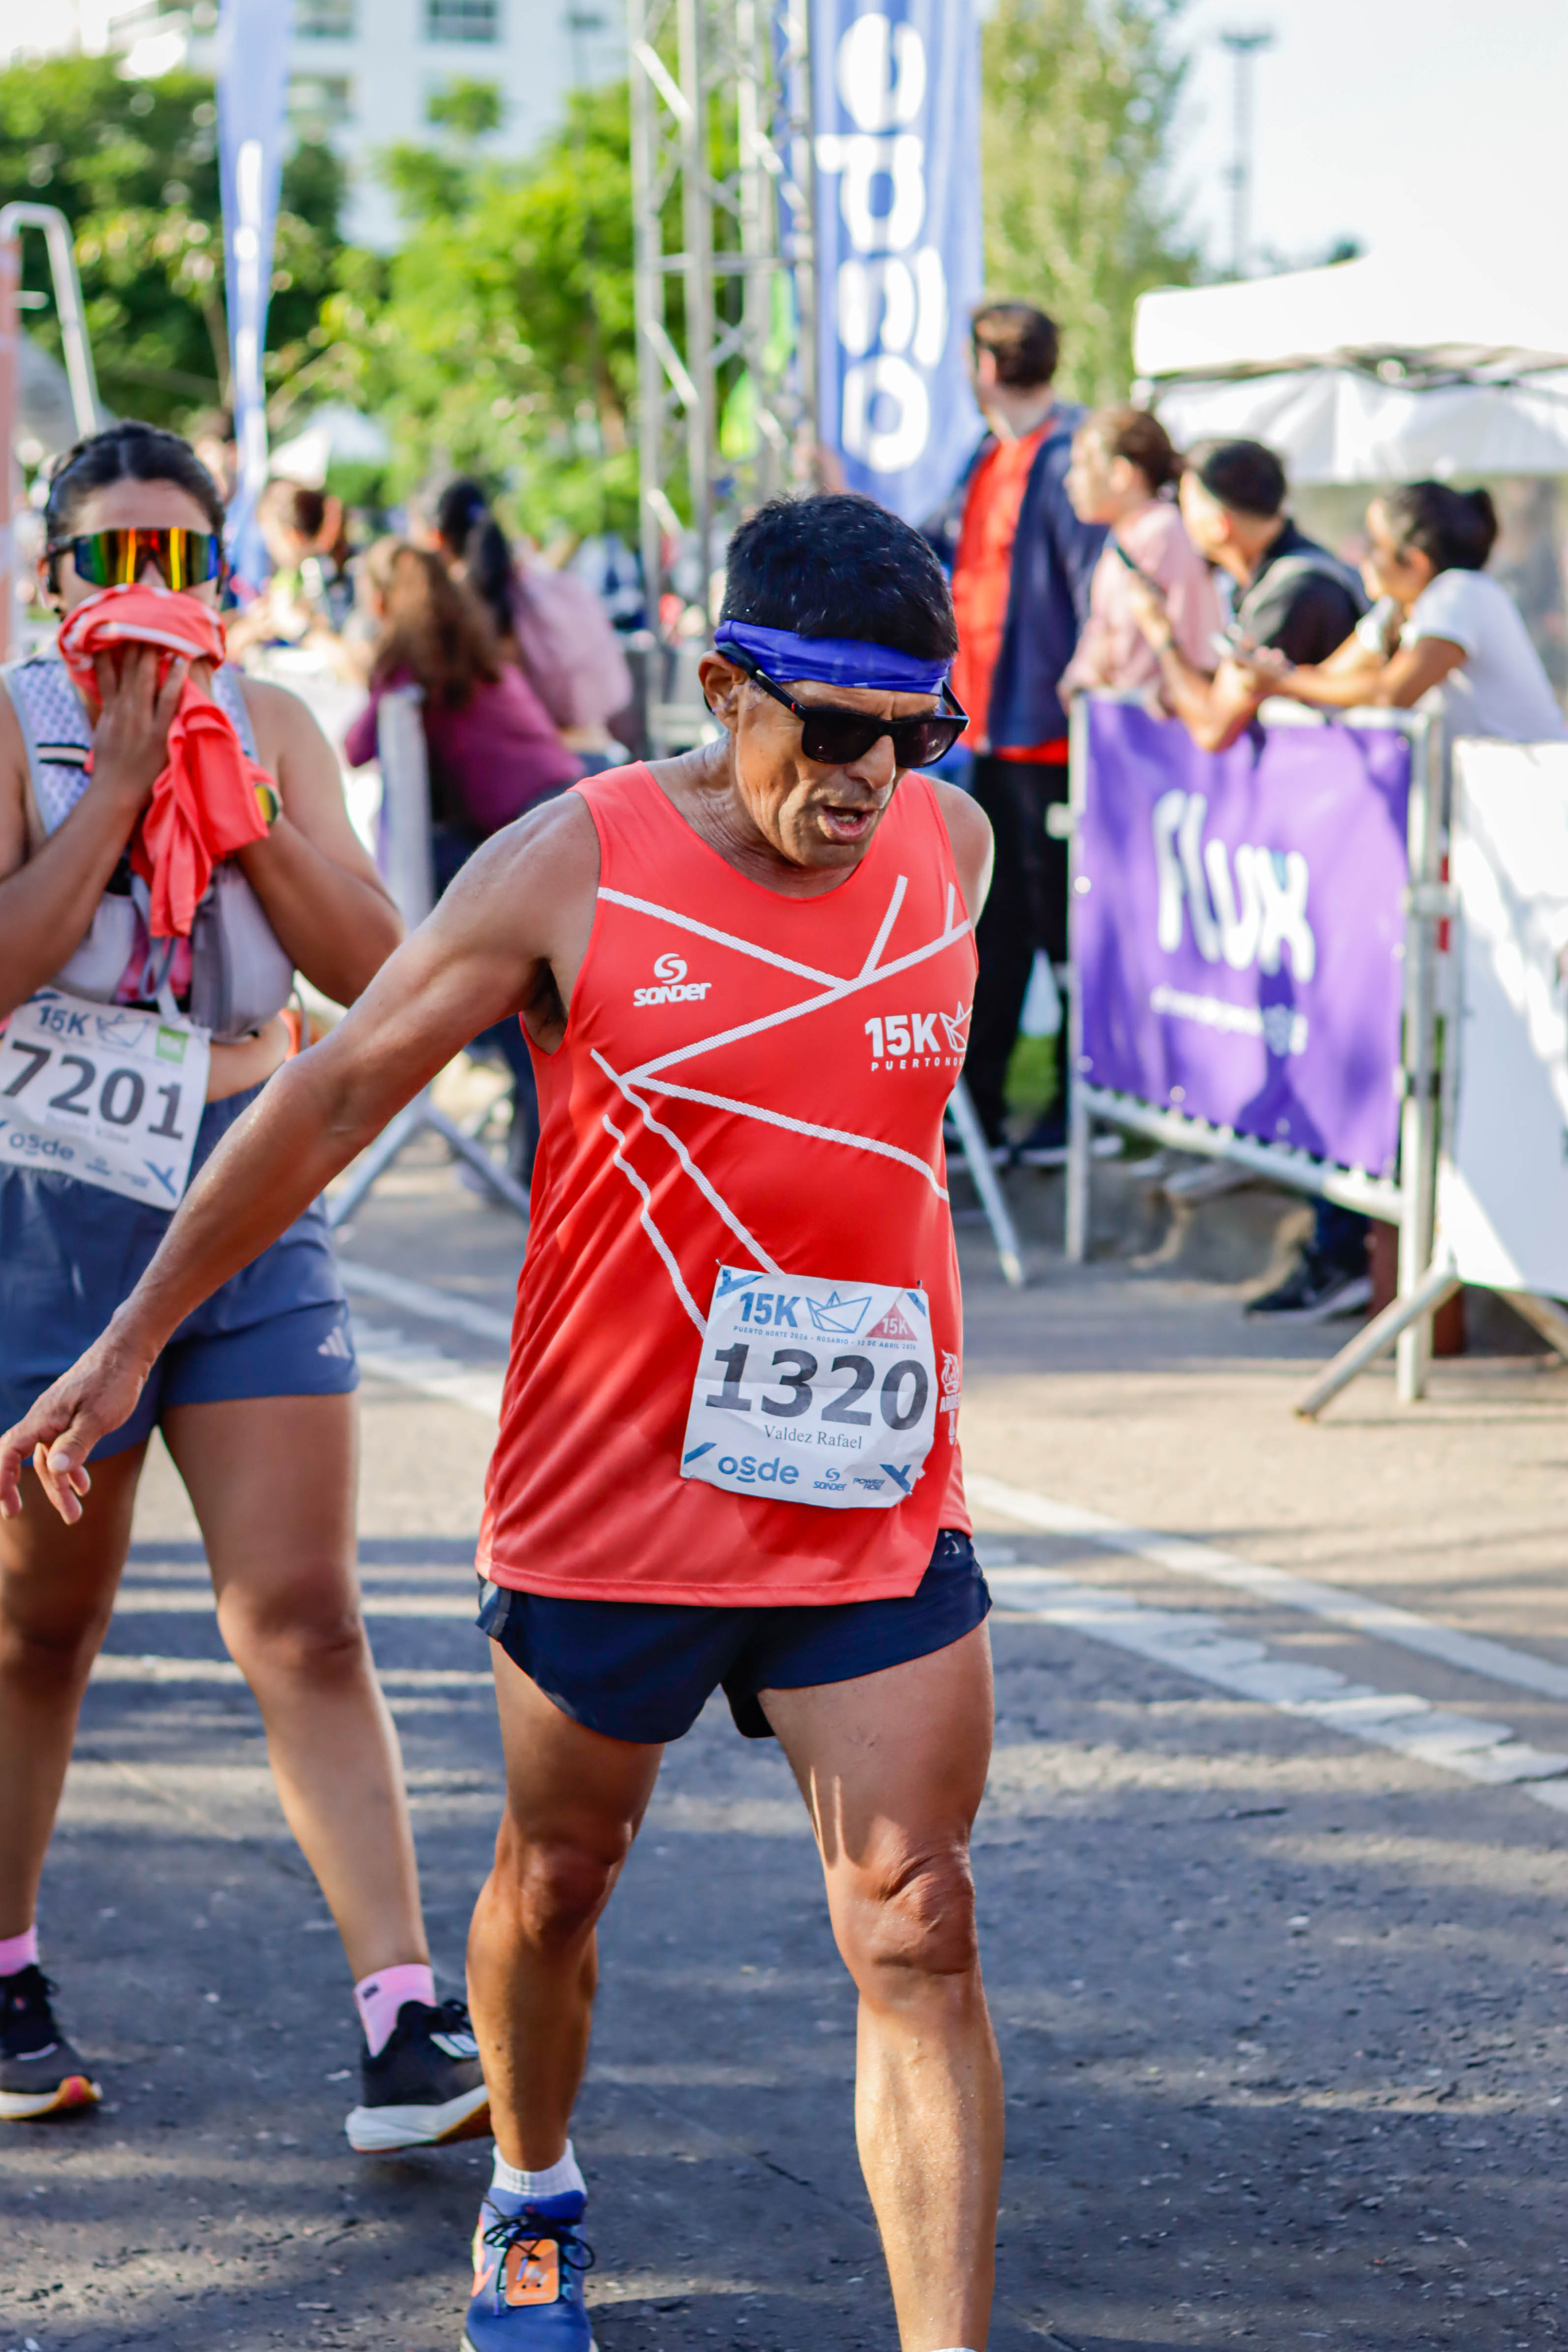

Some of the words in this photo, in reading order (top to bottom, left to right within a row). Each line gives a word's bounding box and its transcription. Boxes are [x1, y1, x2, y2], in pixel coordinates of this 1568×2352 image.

[816, 13, 947, 473] osde
[39, 1004, 89, 1036] 15K
[864, 1013, 941, 1058] 15K
[871, 1057, 940, 1072] PUERTO
[2, 1039, 183, 1141] 7201
[9, 1133, 74, 1159] osde
[739, 1291, 801, 1328] 15K
[734, 1325, 763, 1335] PUERTO
[817, 1336, 848, 1345] ROSARIO
[882, 1318, 909, 1335] 15K
[706, 1342, 929, 1430] 1320
[765, 1424, 812, 1443] Valdez
[817, 1431, 862, 1449] Rafael
[718, 1456, 799, 1484] osde
